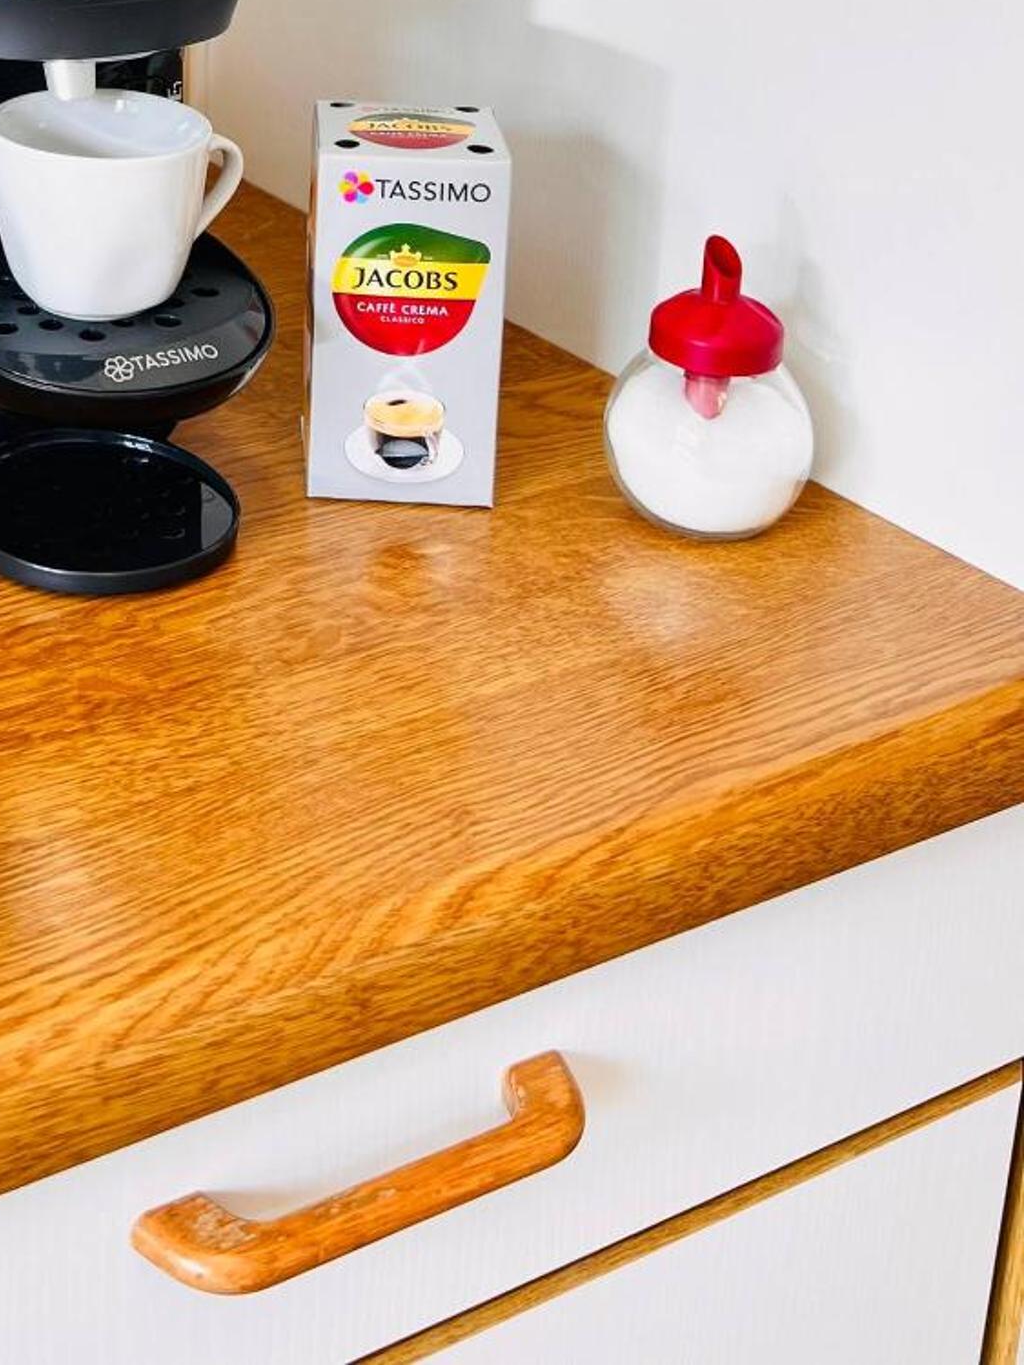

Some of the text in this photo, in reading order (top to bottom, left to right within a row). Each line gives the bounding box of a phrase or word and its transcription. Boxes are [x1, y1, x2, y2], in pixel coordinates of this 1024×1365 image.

[375, 178, 492, 203] TASSIMO
[352, 267, 459, 292] JACOBS
[380, 315, 426, 325] CLASSICO
[401, 304, 449, 317] CREMA
[130, 344, 219, 371] TASSIMO
